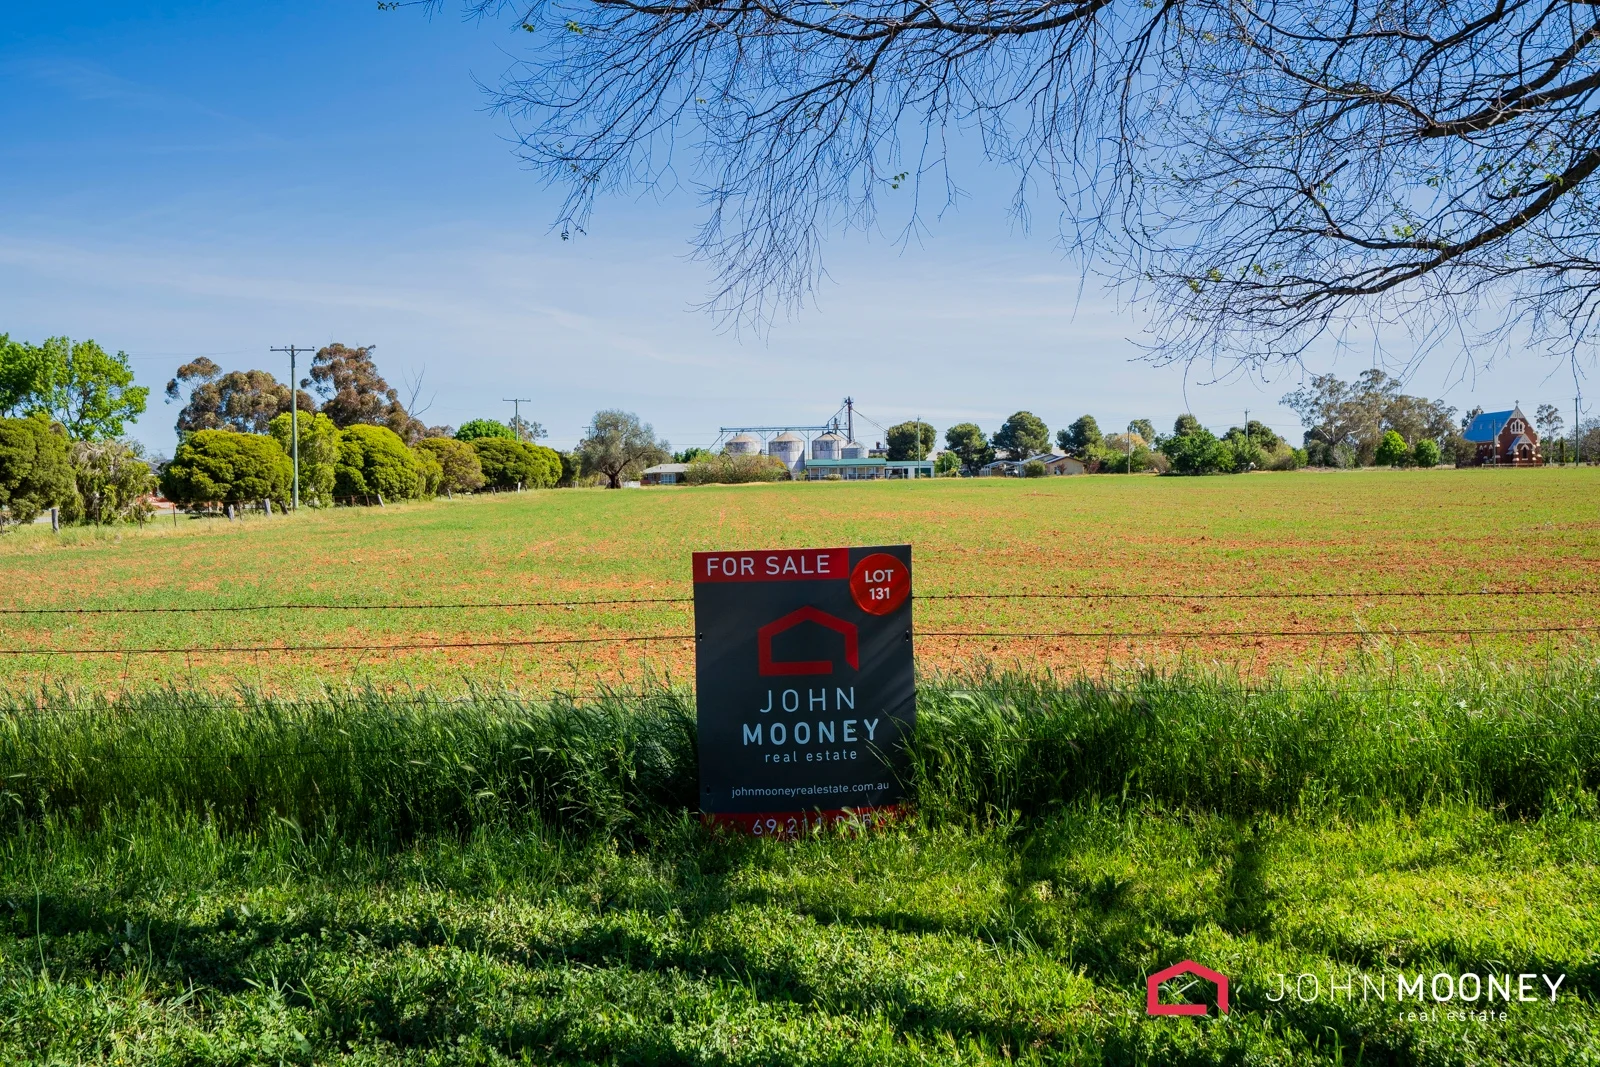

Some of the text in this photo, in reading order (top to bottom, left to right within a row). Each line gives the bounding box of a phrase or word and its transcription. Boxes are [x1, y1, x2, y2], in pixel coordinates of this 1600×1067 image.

[706, 554, 831, 577] FOR SALE
[864, 569, 894, 583] LOT
[868, 587, 891, 600] 131
[759, 686, 855, 713] JOHN
[742, 718, 879, 746] MOONEY
[764, 749, 858, 763] real estate
[731, 782, 890, 799] johnmooneyrealestate.com.au
[752, 818, 777, 835] 69
